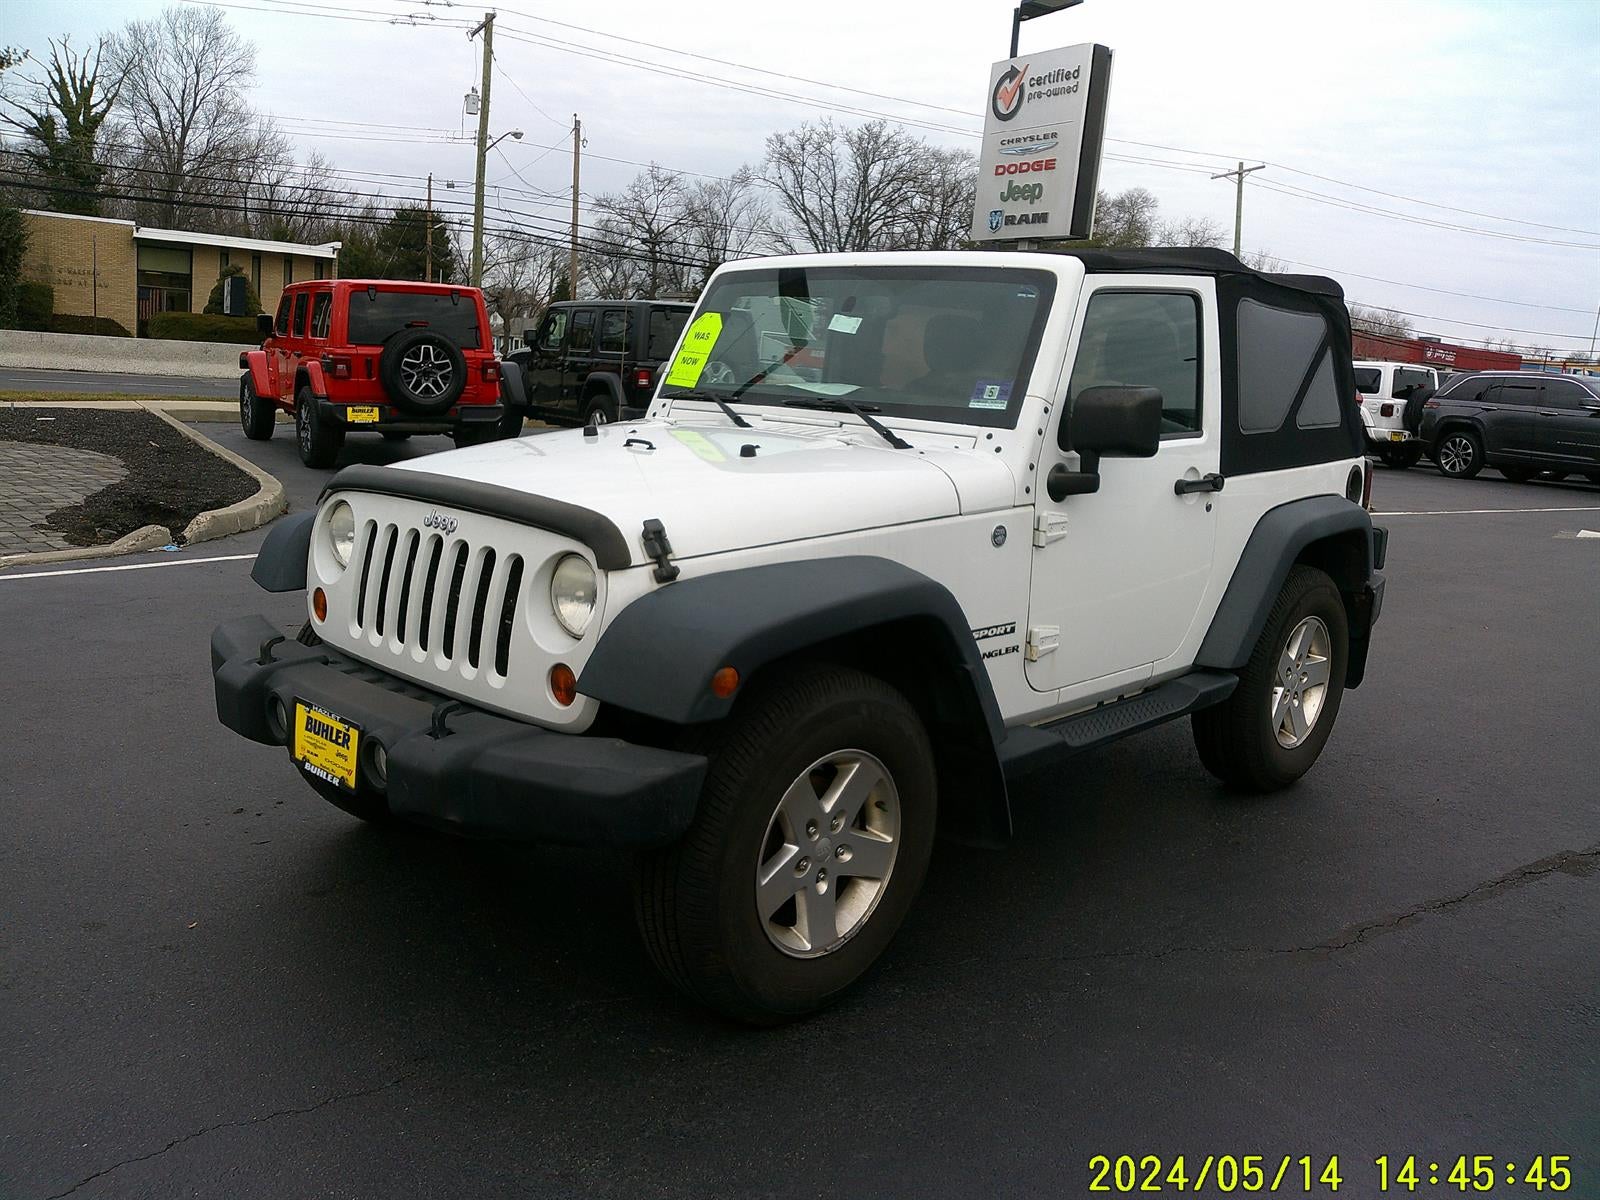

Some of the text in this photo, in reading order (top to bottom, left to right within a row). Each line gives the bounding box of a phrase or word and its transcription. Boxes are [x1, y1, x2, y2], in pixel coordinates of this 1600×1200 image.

[1029, 65, 1081, 87] certified
[1027, 81, 1079, 103] pre-owned
[1000, 132, 1058, 145] CHRYSLER
[995, 158, 1057, 176] DODGE
[1000, 180, 1043, 205] Jeep
[1004, 212, 1049, 226] RAM
[694, 332, 711, 341] WAS
[681, 356, 700, 366] NOW
[423, 509, 459, 536] Jeep
[972, 624, 1015, 640] SPORT
[982, 644, 1020, 660] NGLER
[312, 705, 341, 722] HAZLET
[305, 715, 351, 750] BUHLER
[304, 761, 340, 787] BUHLER
